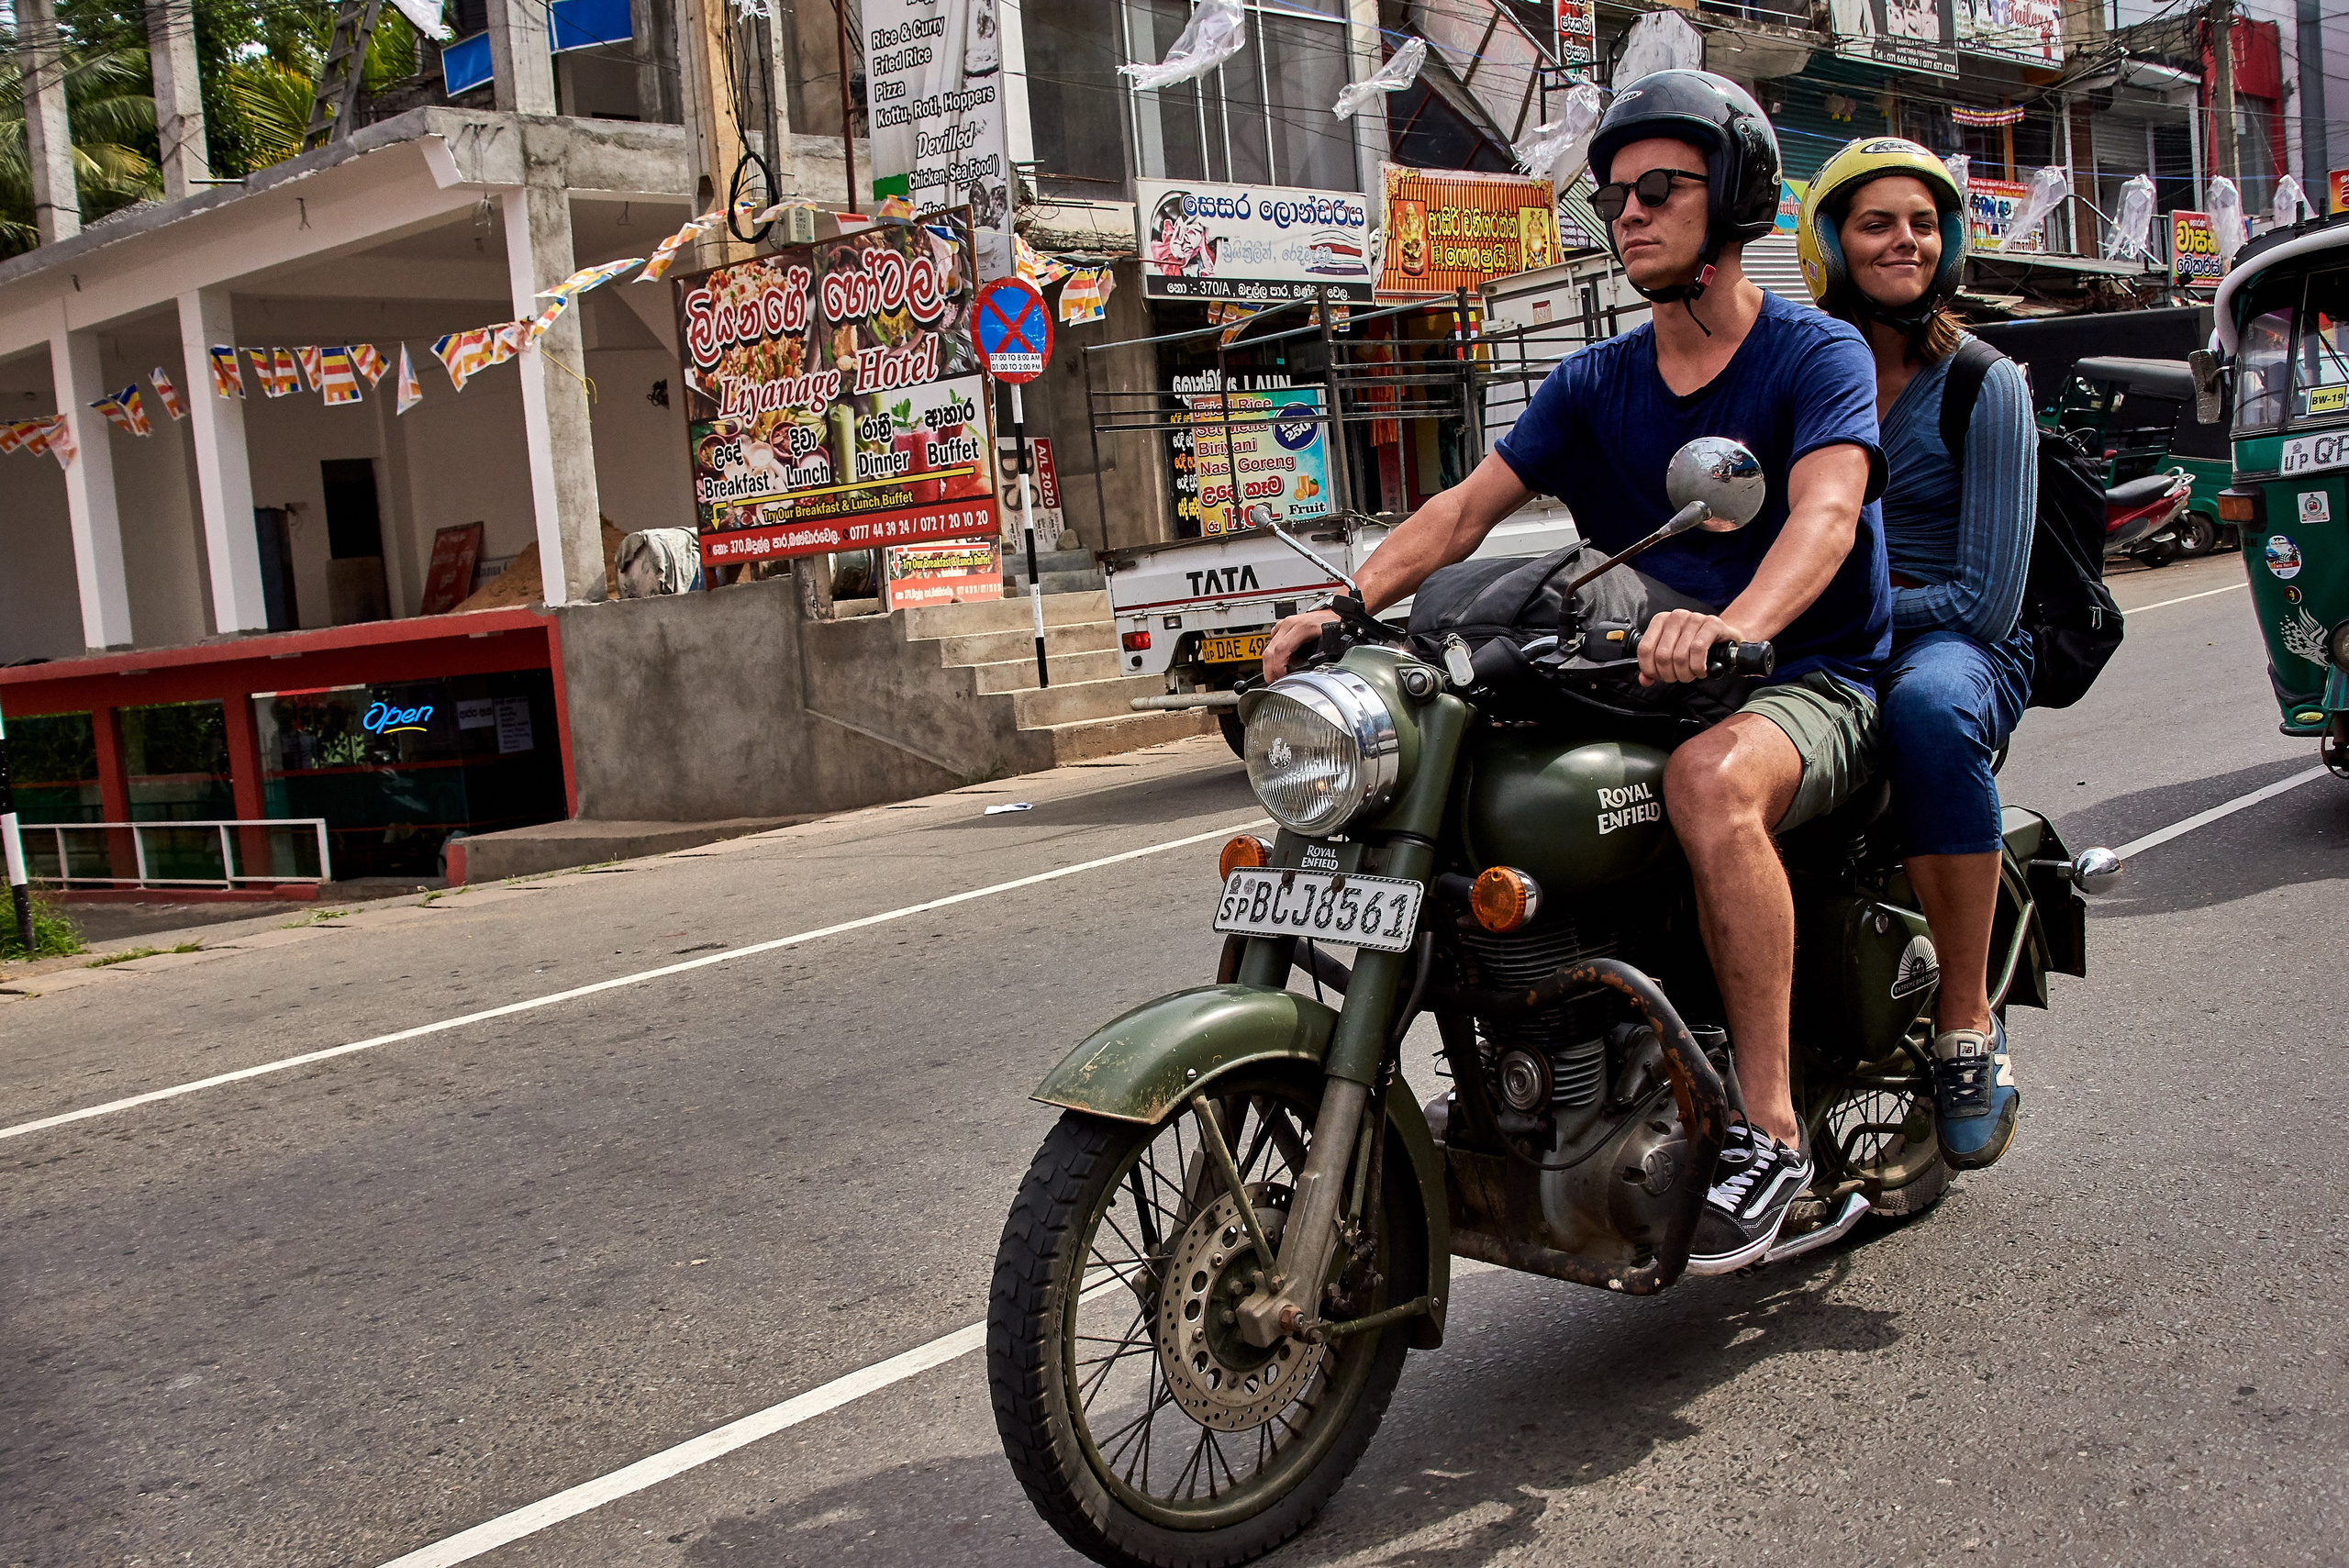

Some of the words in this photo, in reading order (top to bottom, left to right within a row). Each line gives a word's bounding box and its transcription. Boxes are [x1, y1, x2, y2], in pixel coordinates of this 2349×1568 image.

[872, 31, 897, 50] Rice
[900, 23, 910, 42] &
[913, 17, 944, 39] Curry
[874, 50, 905, 76] Fried
[905, 47, 932, 68] Rice
[874, 81, 906, 102] Pizza
[876, 106, 911, 128] Kottu,
[913, 96, 941, 119] Roti,
[943, 86, 995, 112] Hoppers
[917, 121, 975, 160] Devilled
[908, 167, 948, 190] Chicken,
[949, 162, 969, 183] Sea
[1199, 281, 1230, 295] 370/A
[718, 369, 841, 428] Liyanage
[853, 332, 939, 396] Hotel
[1238, 398, 1272, 414] Rice
[2311, 393, 2343, 406] BW-19
[704, 472, 770, 500] Breakfast
[785, 462, 830, 489] Lunch
[857, 450, 909, 476] Dinner
[926, 437, 979, 467] Buffet
[1037, 445, 1048, 467] A/L
[1199, 462, 1231, 476] Nas
[1238, 455, 1296, 472] Goreng
[1041, 473, 1055, 506] 2020
[763, 509, 777, 523] Try
[778, 507, 793, 520] Our
[796, 501, 841, 517] Breakfast
[841, 499, 850, 512] &
[852, 495, 880, 511] Lunch
[883, 491, 914, 507] Buffet
[1288, 502, 1326, 516] Fruit
[849, 525, 869, 541] 0777
[873, 523, 884, 538] 44
[885, 521, 896, 536] 39
[898, 519, 910, 535] 24
[920, 517, 937, 532] 072
[949, 513, 961, 528] 20
[963, 511, 974, 527] 10
[976, 509, 988, 525] 20
[923, 554, 952, 569] Breakfast
[1186, 565, 1260, 596] TATA
[1204, 651, 1215, 661] UP
[1216, 640, 1242, 659] DAE
[363, 702, 433, 734] Open
[1597, 782, 1653, 809] ROYAL
[1598, 801, 1661, 835] ENFIELD
[1301, 857, 1339, 871] ENFIELD
[1306, 844, 1337, 858] ROYAL
[1219, 896, 1249, 922] SP
[1895, 981, 1915, 994] EXTREME
